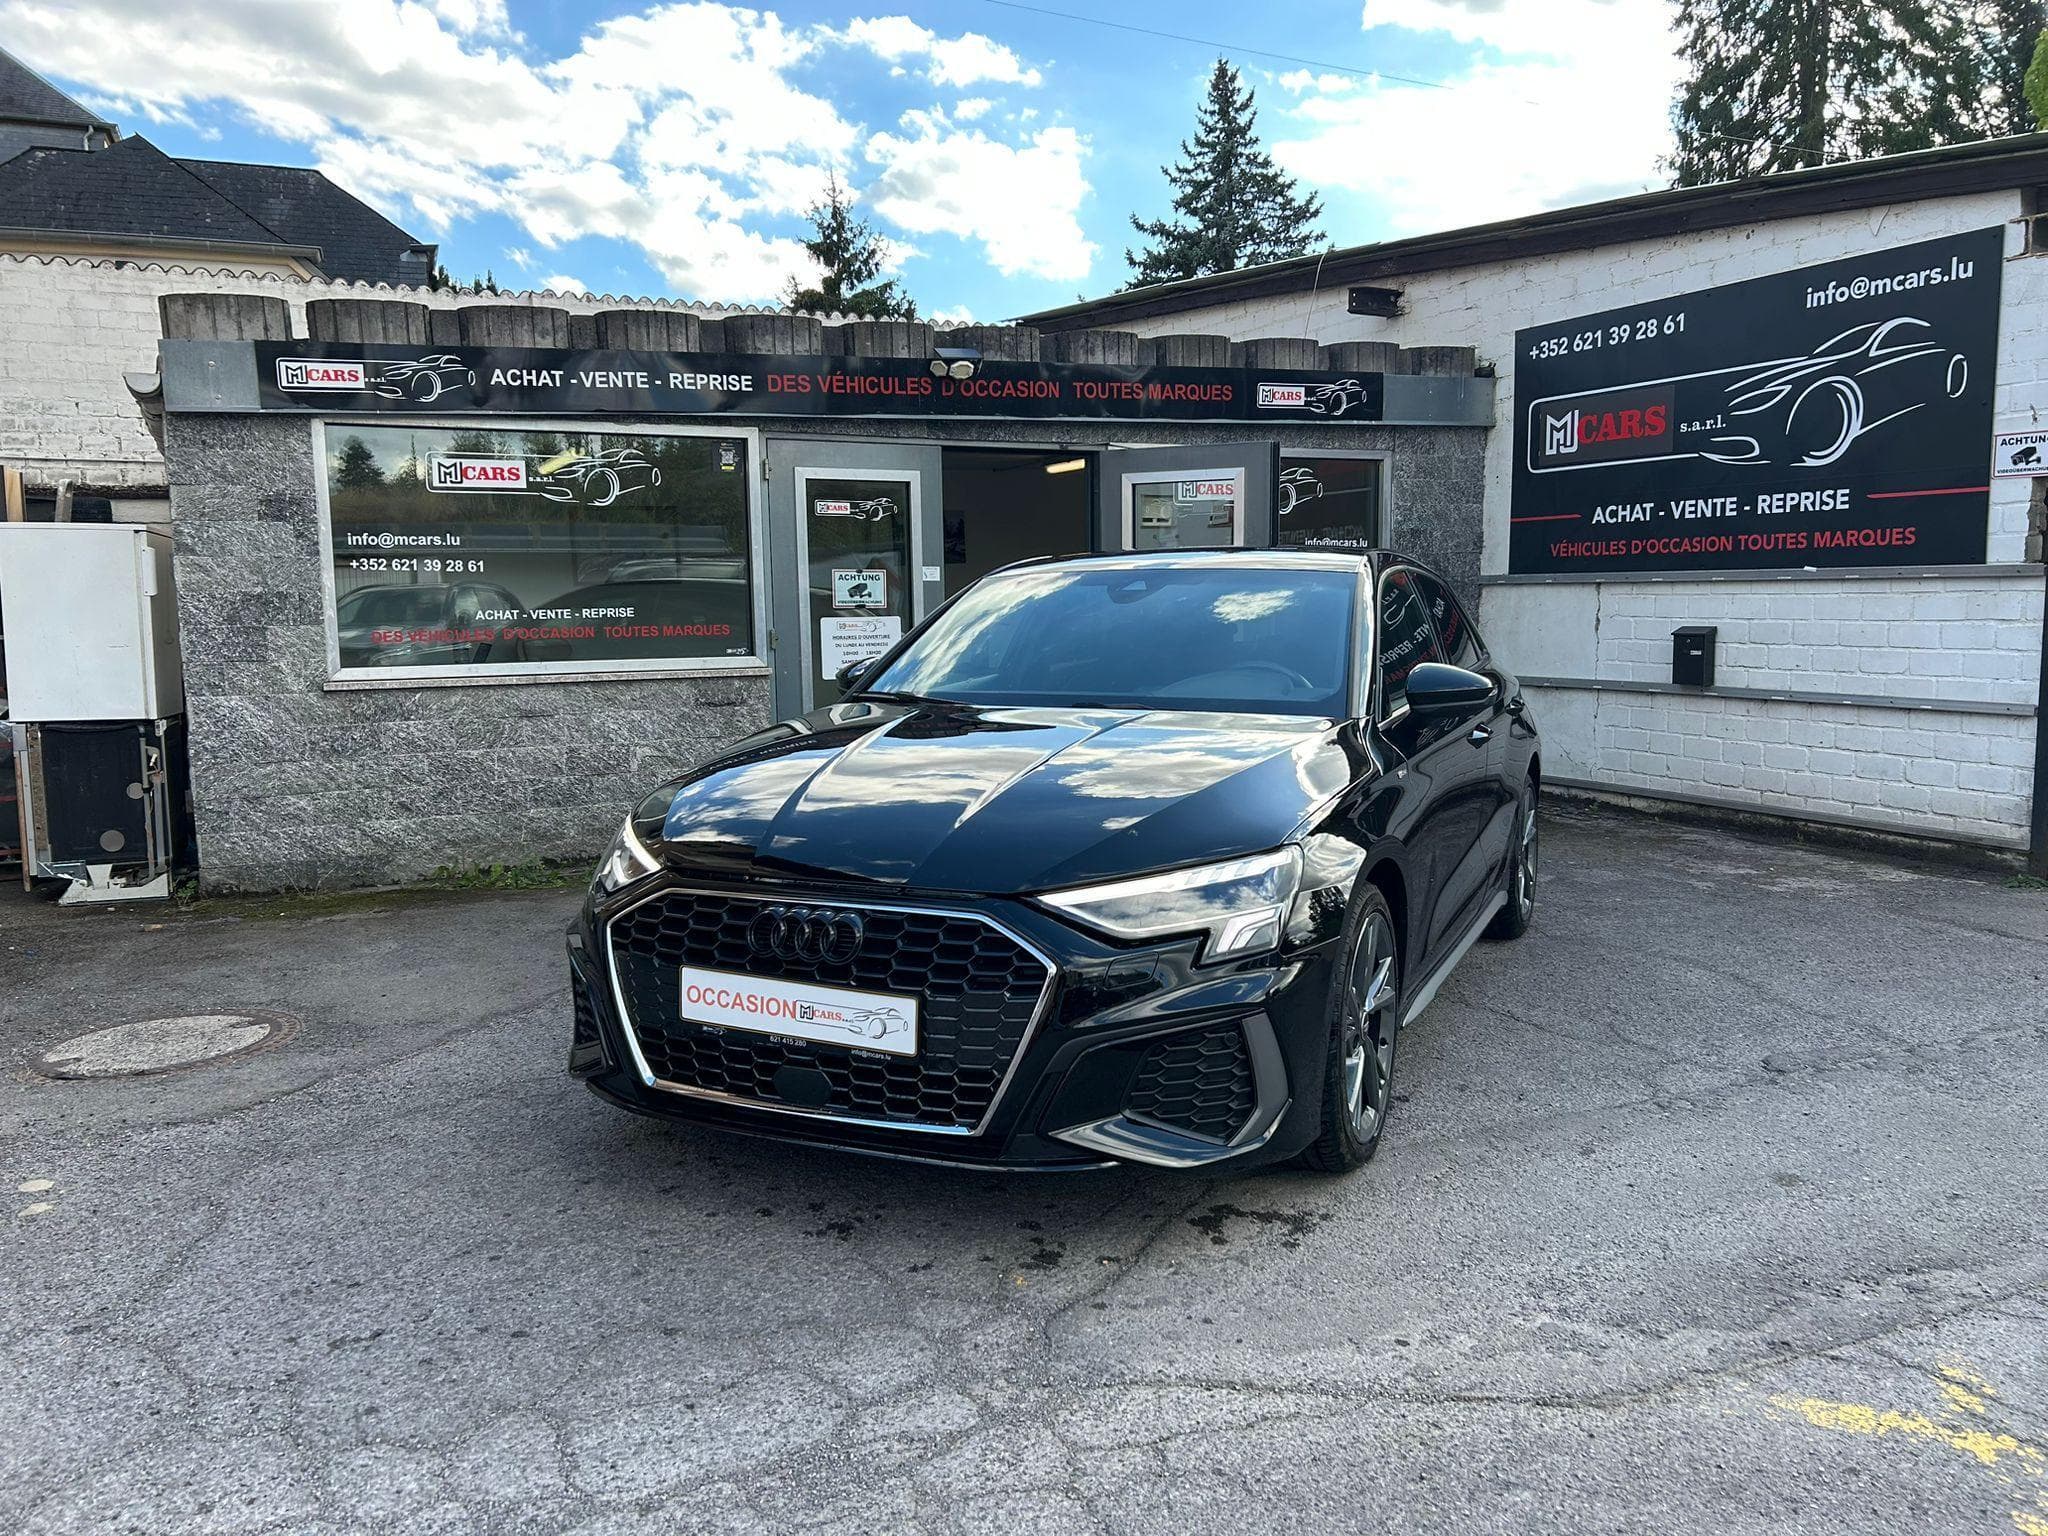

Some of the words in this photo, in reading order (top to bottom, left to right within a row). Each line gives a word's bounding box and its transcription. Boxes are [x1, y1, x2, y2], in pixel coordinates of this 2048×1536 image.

[1806, 256, 1974, 308] info@mcars.lu
[1529, 337, 1568, 359] +352
[1573, 330, 1602, 352] 621
[1609, 324, 1630, 345] 39
[1635, 318, 1657, 341] 28
[1663, 313, 1685, 335] 61
[490, 368, 564, 387] ACHAT
[669, 373, 753, 391] REPRISE
[768, 374, 811, 393] DES
[817, 370, 932, 395] VÉHICULES
[1073, 382, 1143, 399] TOUTES
[1149, 383, 1232, 401] MARQUES
[1680, 415, 1727, 432] s.a.r.l.
[2000, 435, 2048, 447] ACHTUN
[1592, 503, 1654, 524] ACHAT
[1671, 497, 1737, 519] VENTE
[1757, 488, 1850, 514] REPRISE
[347, 533, 460, 548] info@mcars.lu
[1550, 539, 1626, 557] VÉHICULES
[1738, 532, 1807, 551] TOUTES
[1814, 527, 1917, 548] MARQUES
[350, 558, 387, 571] +352
[391, 559, 418, 572] 621
[424, 559, 441, 572] 39
[446, 560, 464, 572] 28
[467, 560, 484, 573] 61
[475, 610, 519, 621] ACHAT
[530, 609, 571, 620] VENTE
[582, 607, 635, 618] REPRISE
[371, 629, 404, 643] DES
[603, 625, 659, 638] TOUTES
[662, 624, 730, 637] MARQUES
[686, 984, 797, 1019] OCCASION
